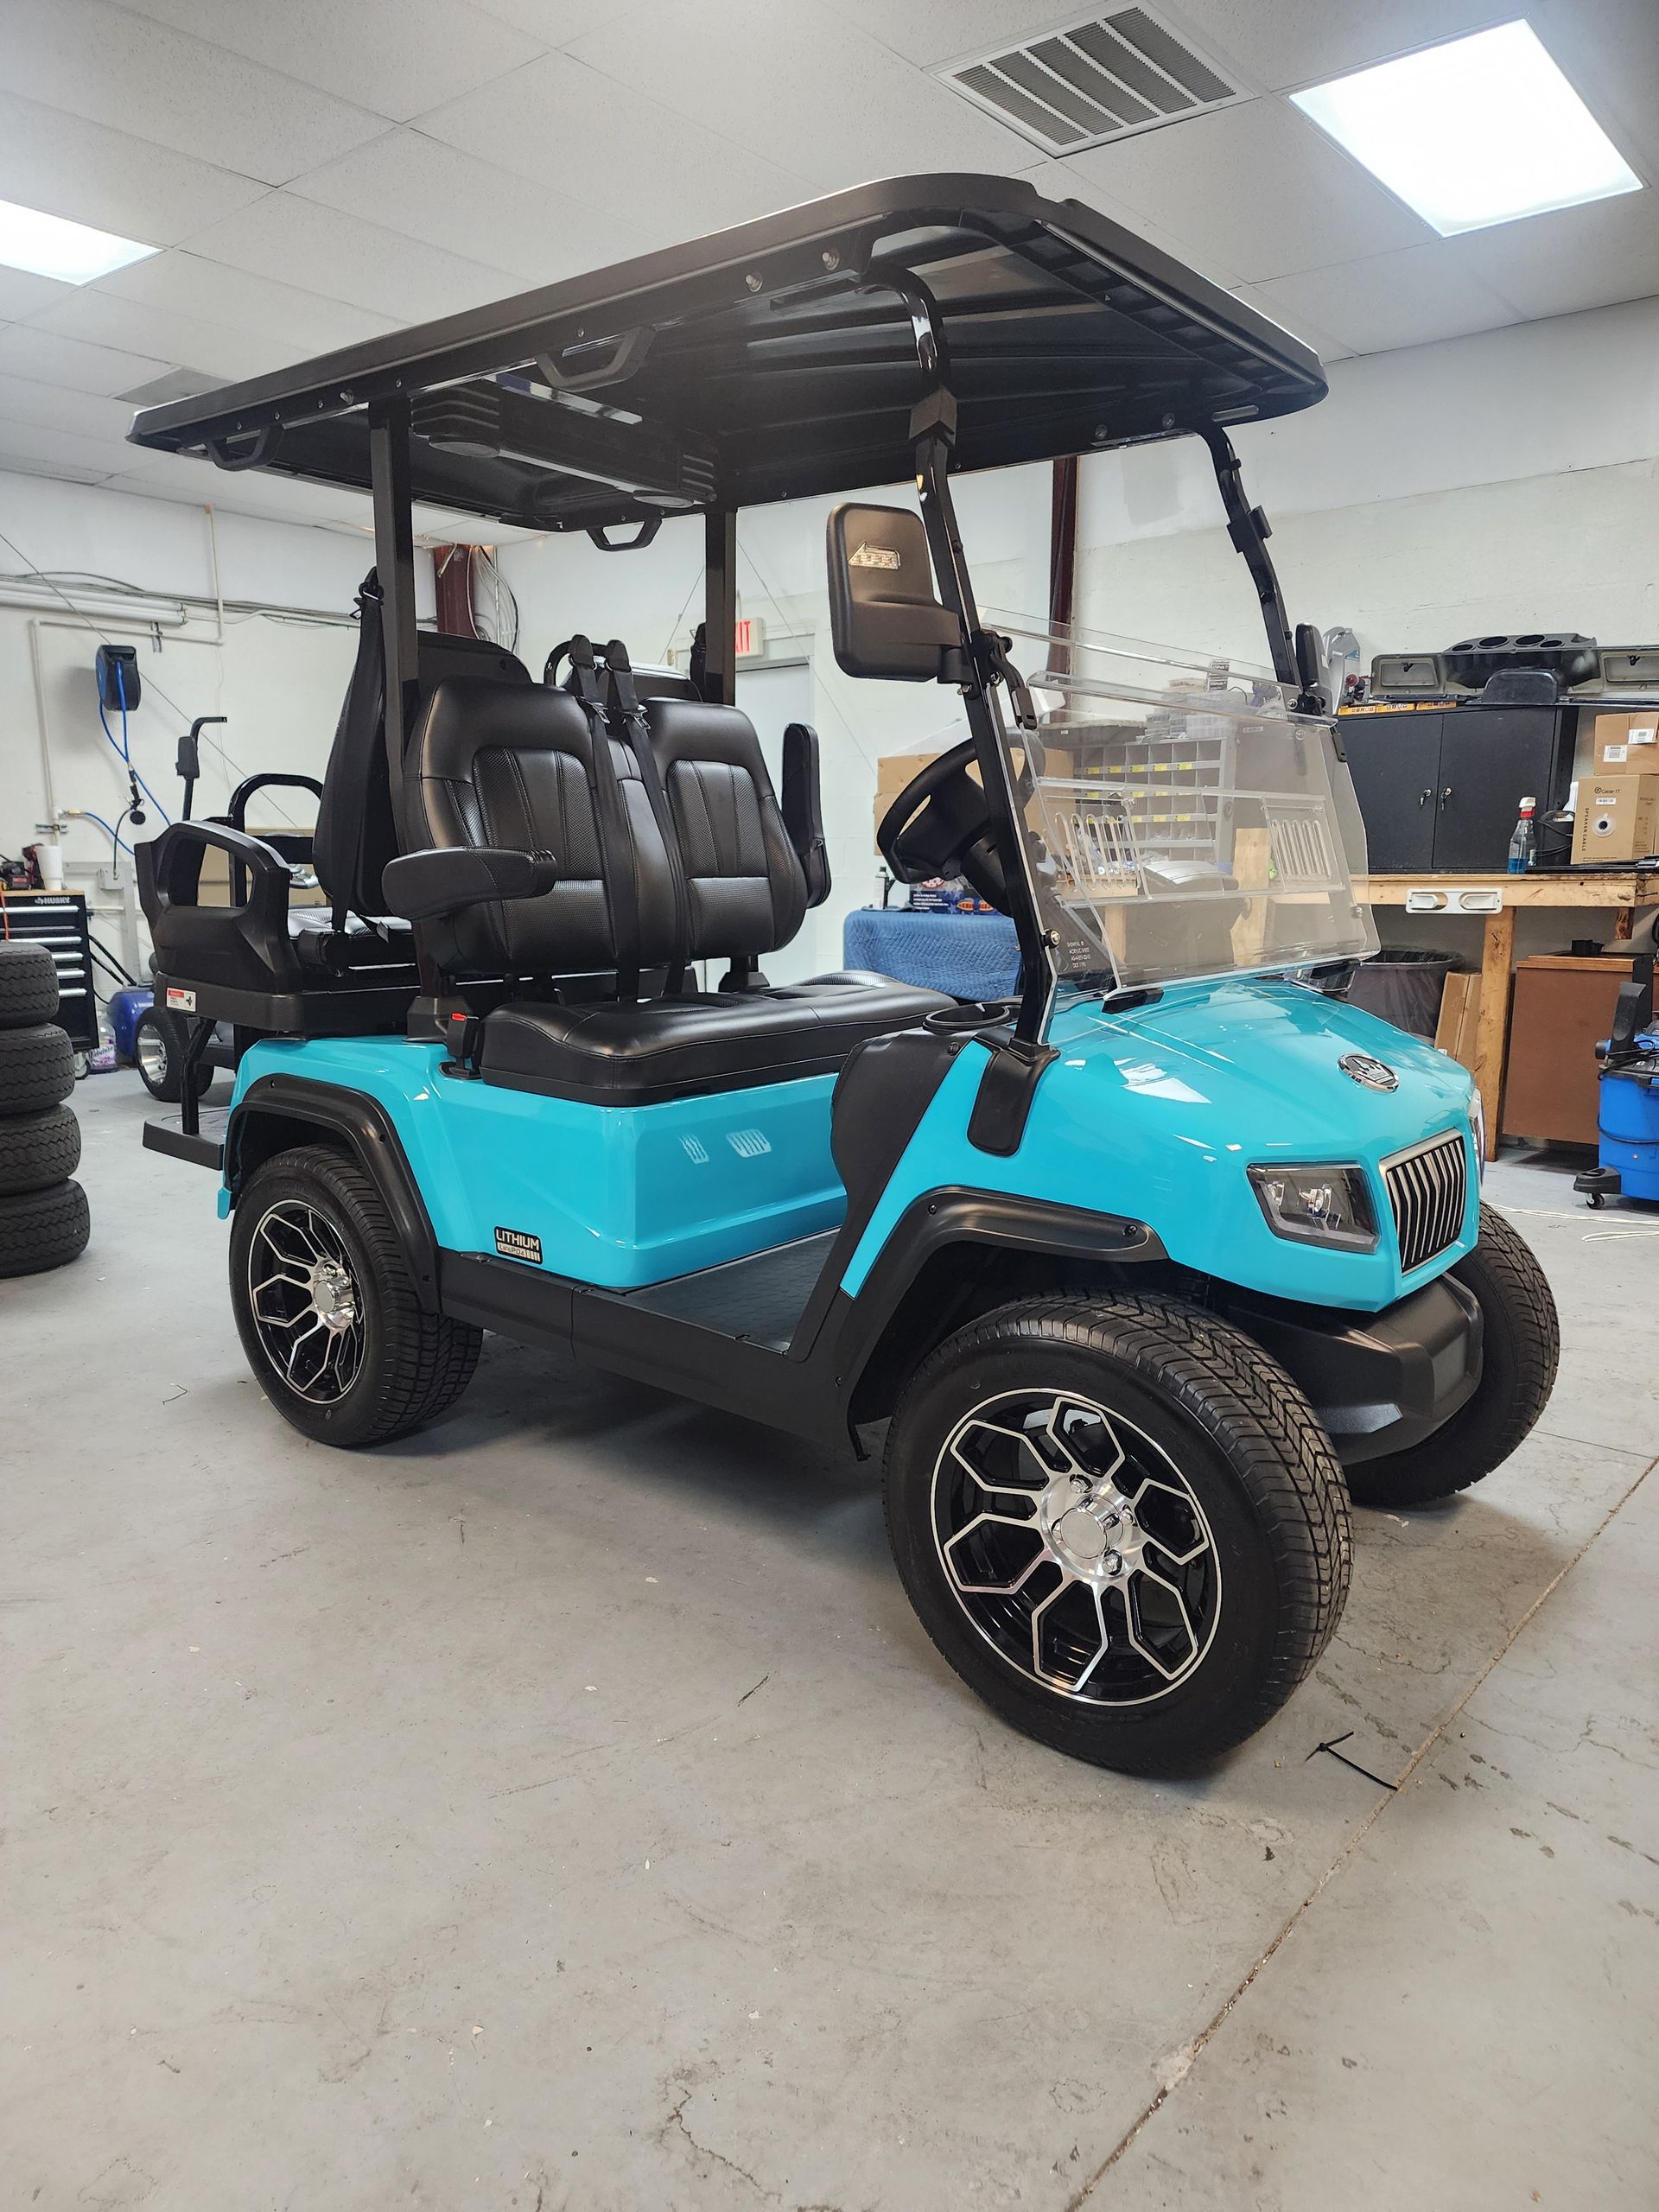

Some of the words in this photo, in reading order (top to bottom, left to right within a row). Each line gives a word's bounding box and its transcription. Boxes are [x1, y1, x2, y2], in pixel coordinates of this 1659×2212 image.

[735, 620, 751, 652] IT
[44, 896, 71, 905] HUSKY
[495, 1229, 540, 1251] LITHIUM
